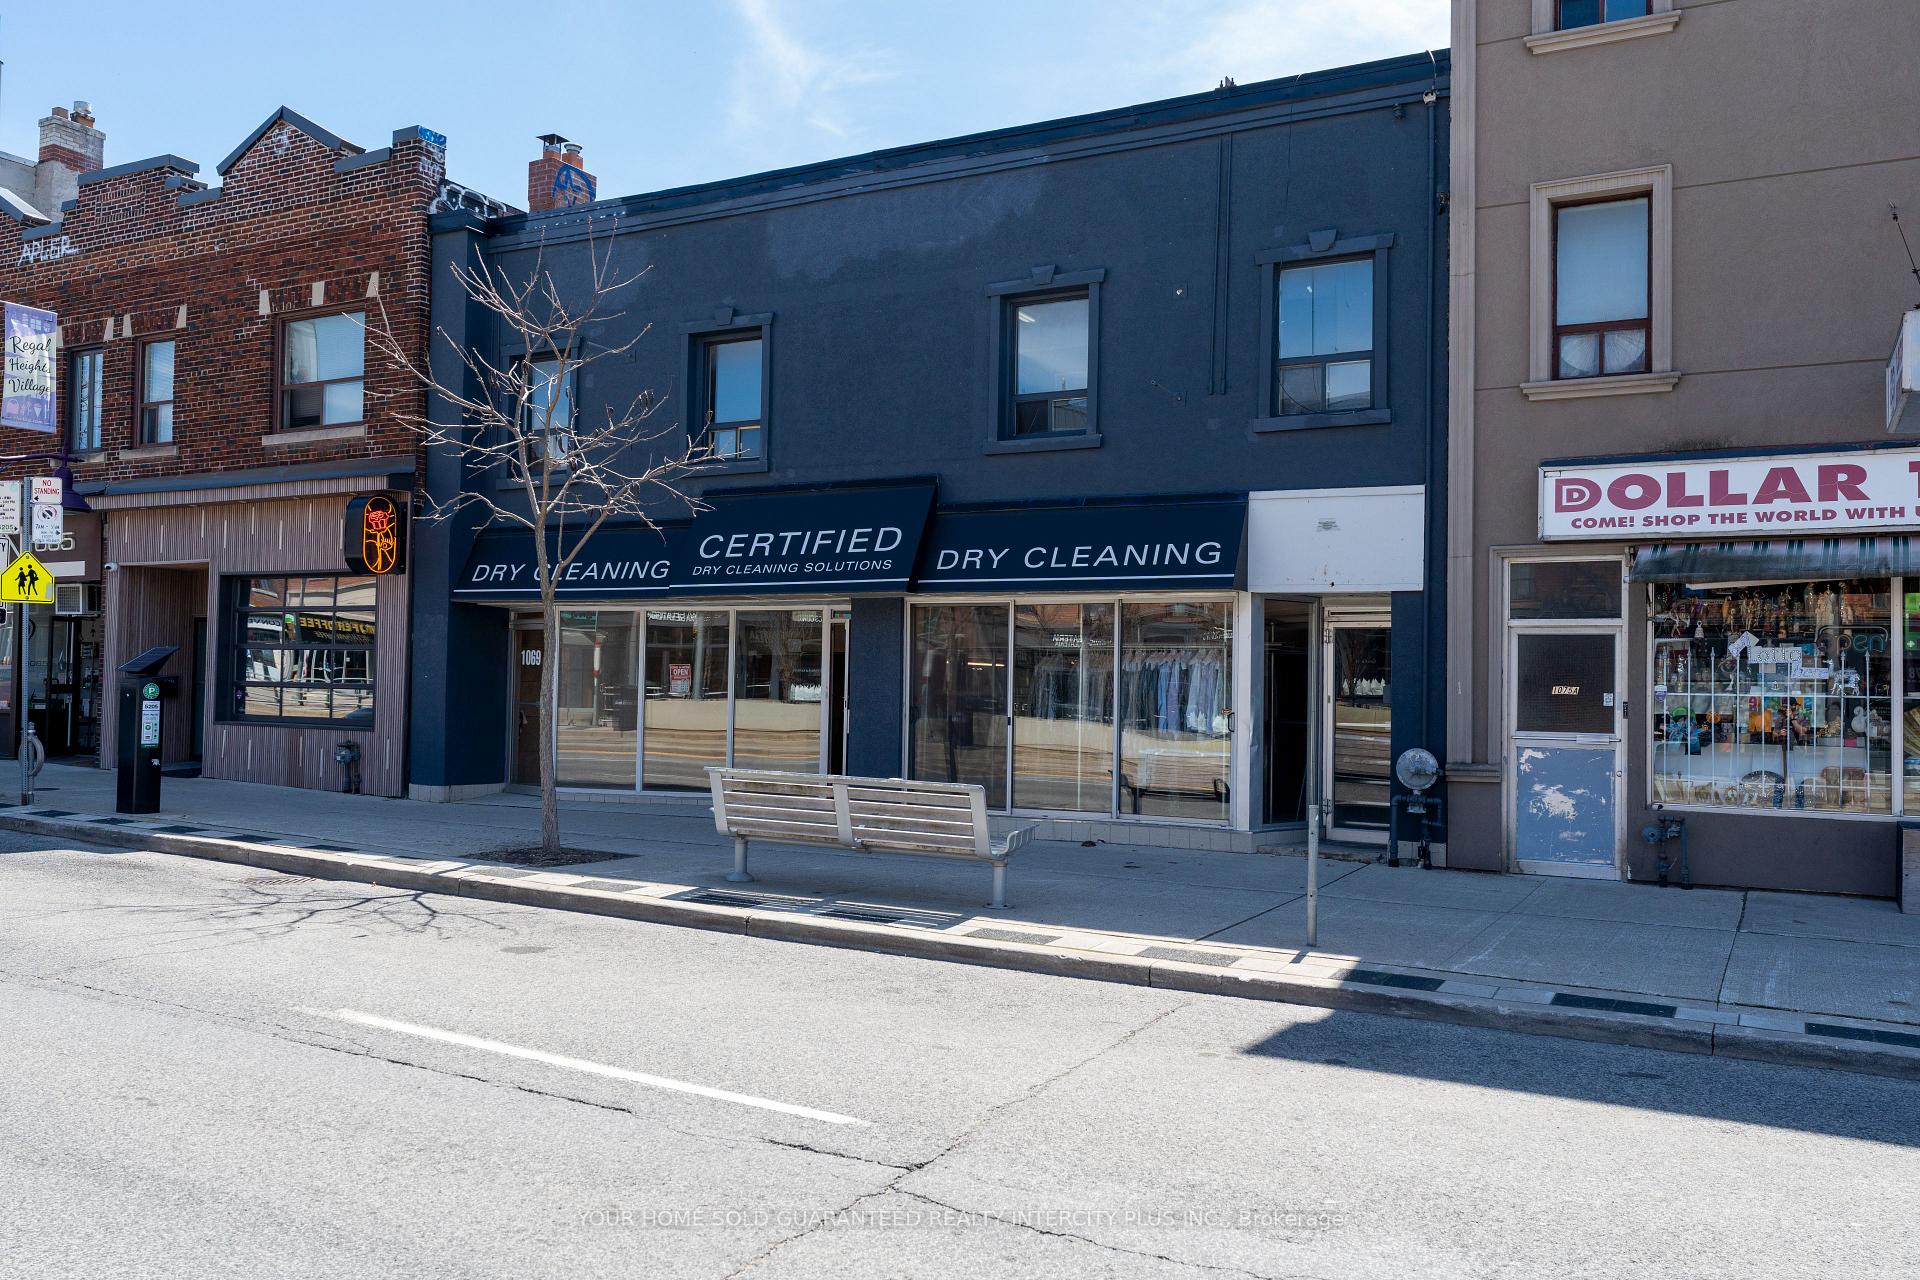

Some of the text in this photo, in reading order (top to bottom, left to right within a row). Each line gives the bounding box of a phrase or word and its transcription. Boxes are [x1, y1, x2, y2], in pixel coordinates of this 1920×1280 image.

[9, 335, 52, 355] Regal
[8, 358, 52, 374] Heights
[8, 378, 51, 396] Village
[34, 487, 60, 495] STANDING
[42, 479, 52, 487] NO
[1555, 463, 1871, 513] DOLLAR
[1570, 516, 1635, 529] COME!
[1642, 514, 1701, 527] SHOP
[1707, 511, 1748, 525] THE
[1755, 509, 1838, 523] WORLD
[1845, 506, 1906, 520] WITH
[699, 526, 903, 559] CERTIFIED
[936, 541, 1222, 570] DRY CLEANING
[471, 562, 527, 582] DRY
[692, 559, 893, 576] DRY CLEANING SOLUTIONS
[520, 649, 542, 666] 1069
[673, 668, 689, 676] OPEN
